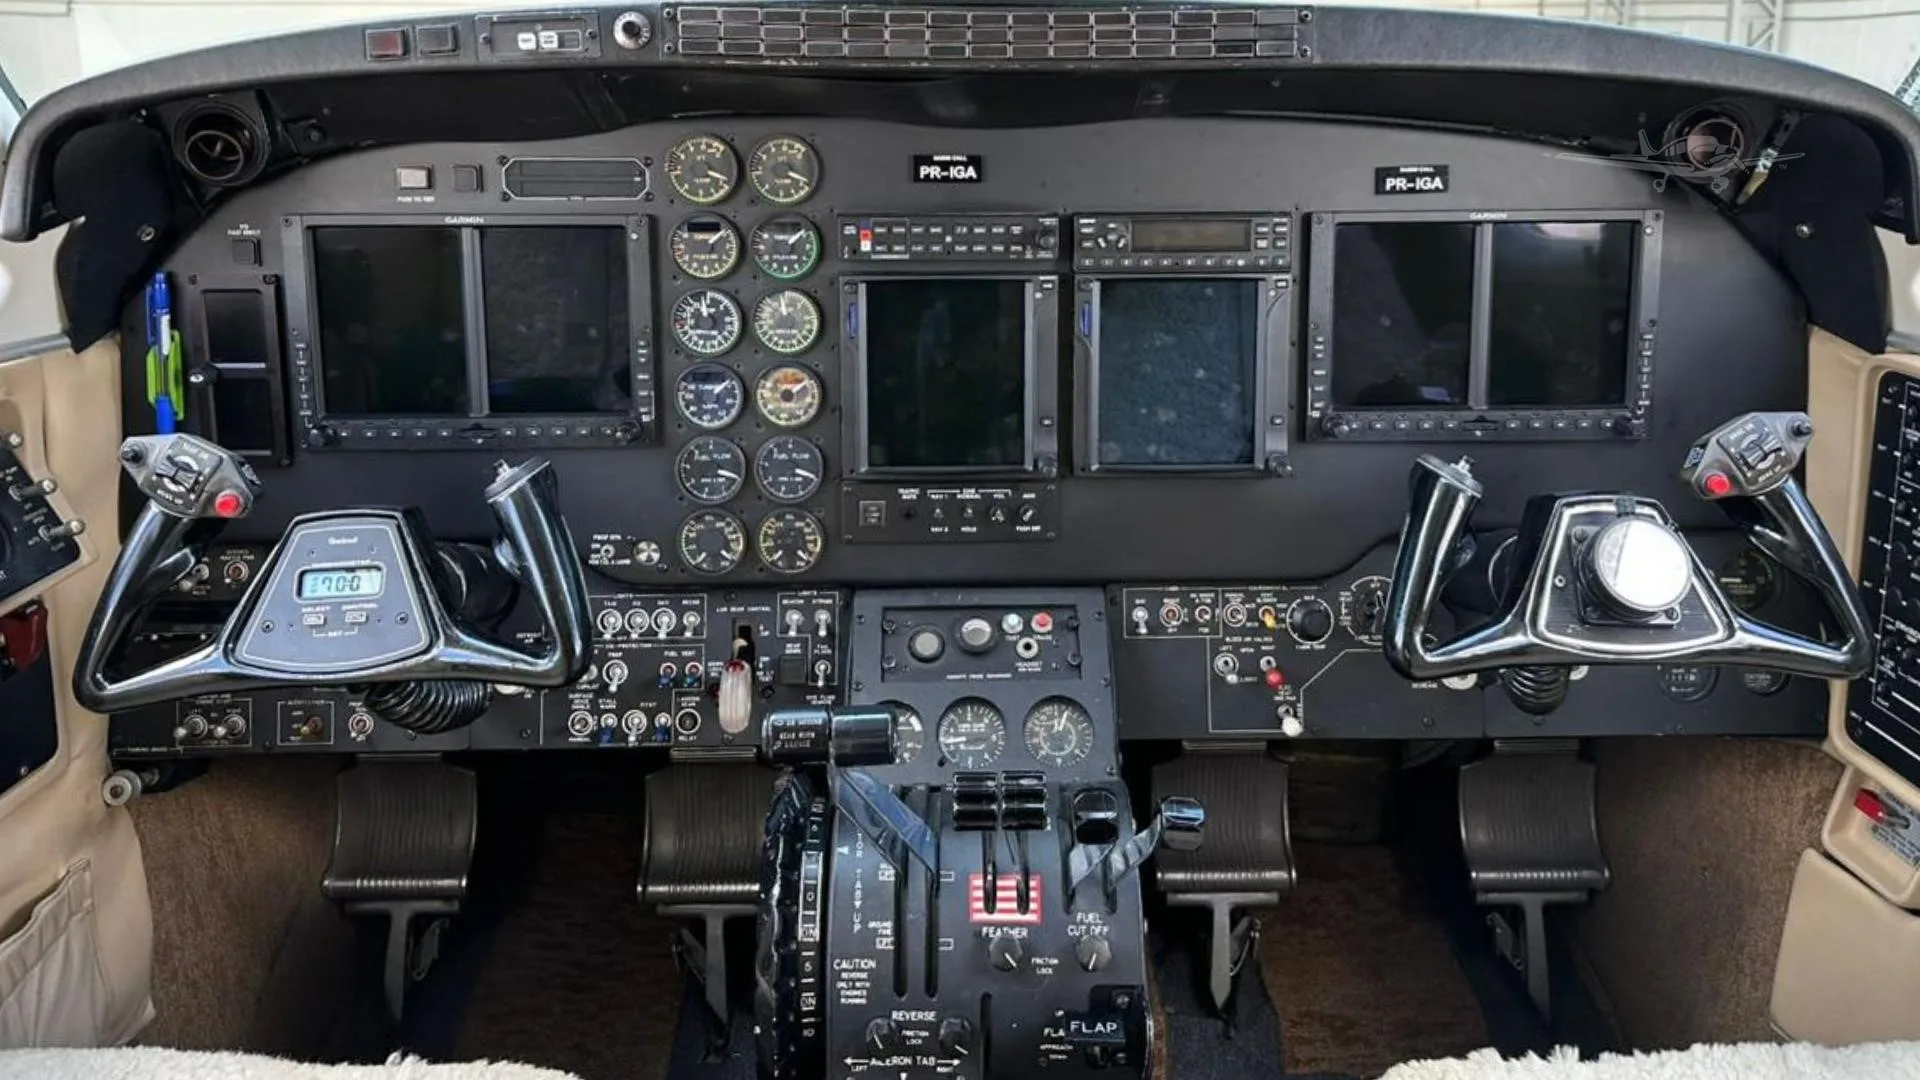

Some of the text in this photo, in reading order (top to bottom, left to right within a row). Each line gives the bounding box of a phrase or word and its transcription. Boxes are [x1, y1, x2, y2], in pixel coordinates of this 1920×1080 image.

[919, 165, 978, 179] PR-IGA
[1385, 176, 1445, 191] PR-IGA
[445, 216, 485, 224] GARMIN
[1470, 212, 1508, 220] GARMIN
[1076, 912, 1103, 924] FUEL
[981, 926, 1029, 939] FEATHER
[1067, 925, 1110, 936] CUT OFF
[833, 958, 877, 970] CAUTION
[1031, 957, 1060, 966] FRICTION
[841, 972, 869, 980] REVERSE
[1036, 967, 1053, 975] LOCK
[891, 1010, 937, 1022] REVERSE
[1043, 1027, 1066, 1037] FLA
[1069, 1021, 1118, 1034] FLAP
[916, 1056, 936, 1066] TAB
